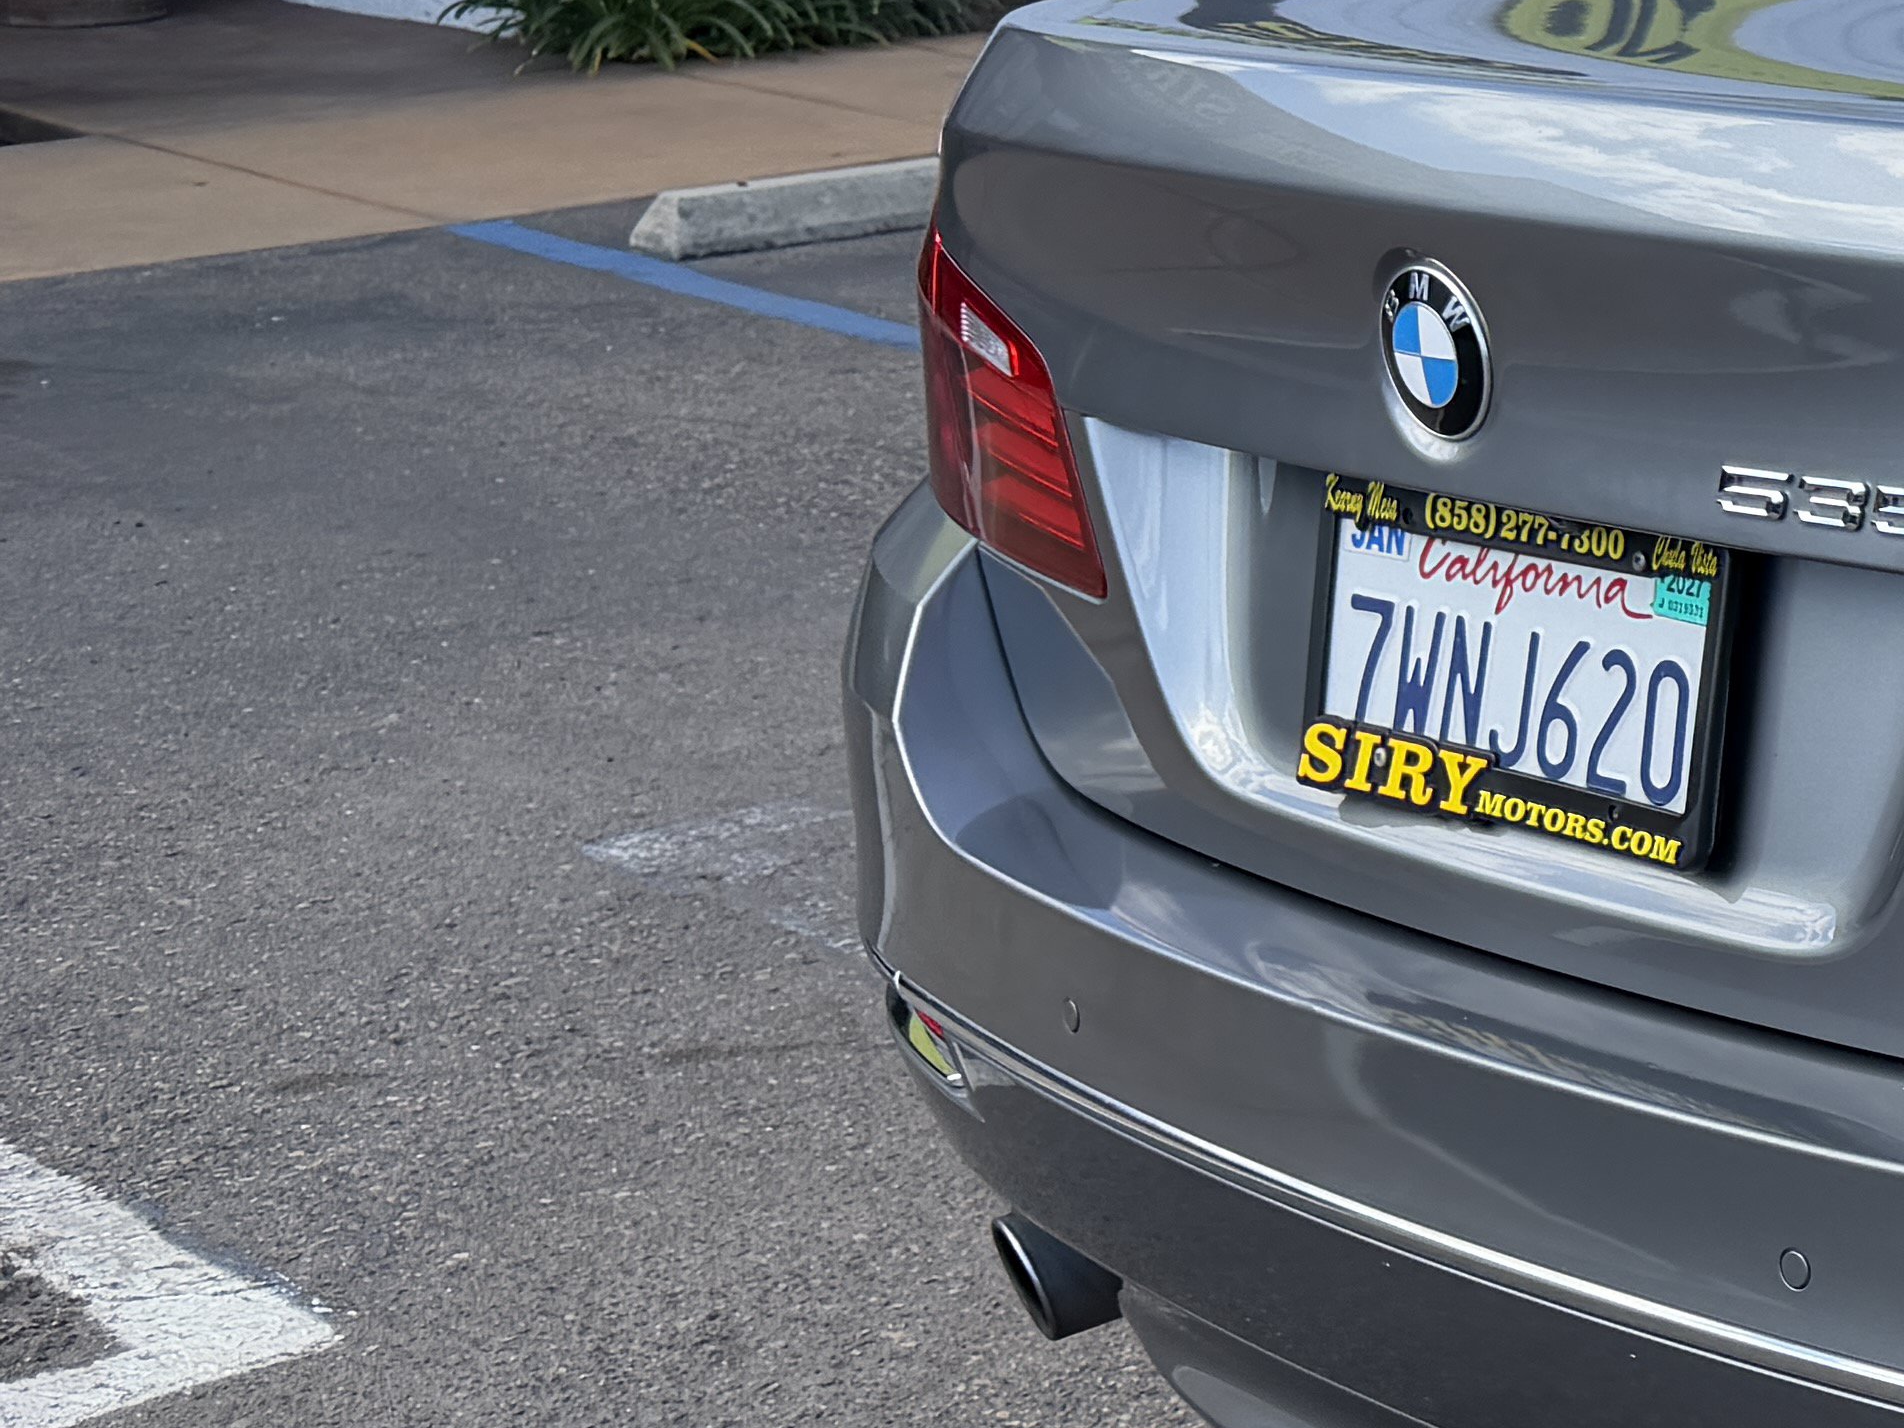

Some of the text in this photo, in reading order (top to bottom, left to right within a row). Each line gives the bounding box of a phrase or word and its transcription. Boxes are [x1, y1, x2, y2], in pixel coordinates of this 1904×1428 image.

[1385, 271, 1472, 332] BMW
[1351, 524, 1407, 557] JAN
[1425, 492, 1497, 540] (858)
[1419, 536, 1654, 619] California
[1350, 593, 1690, 808] 7WNJ620
[1298, 723, 1682, 866] SIRY MOTORS.COM
